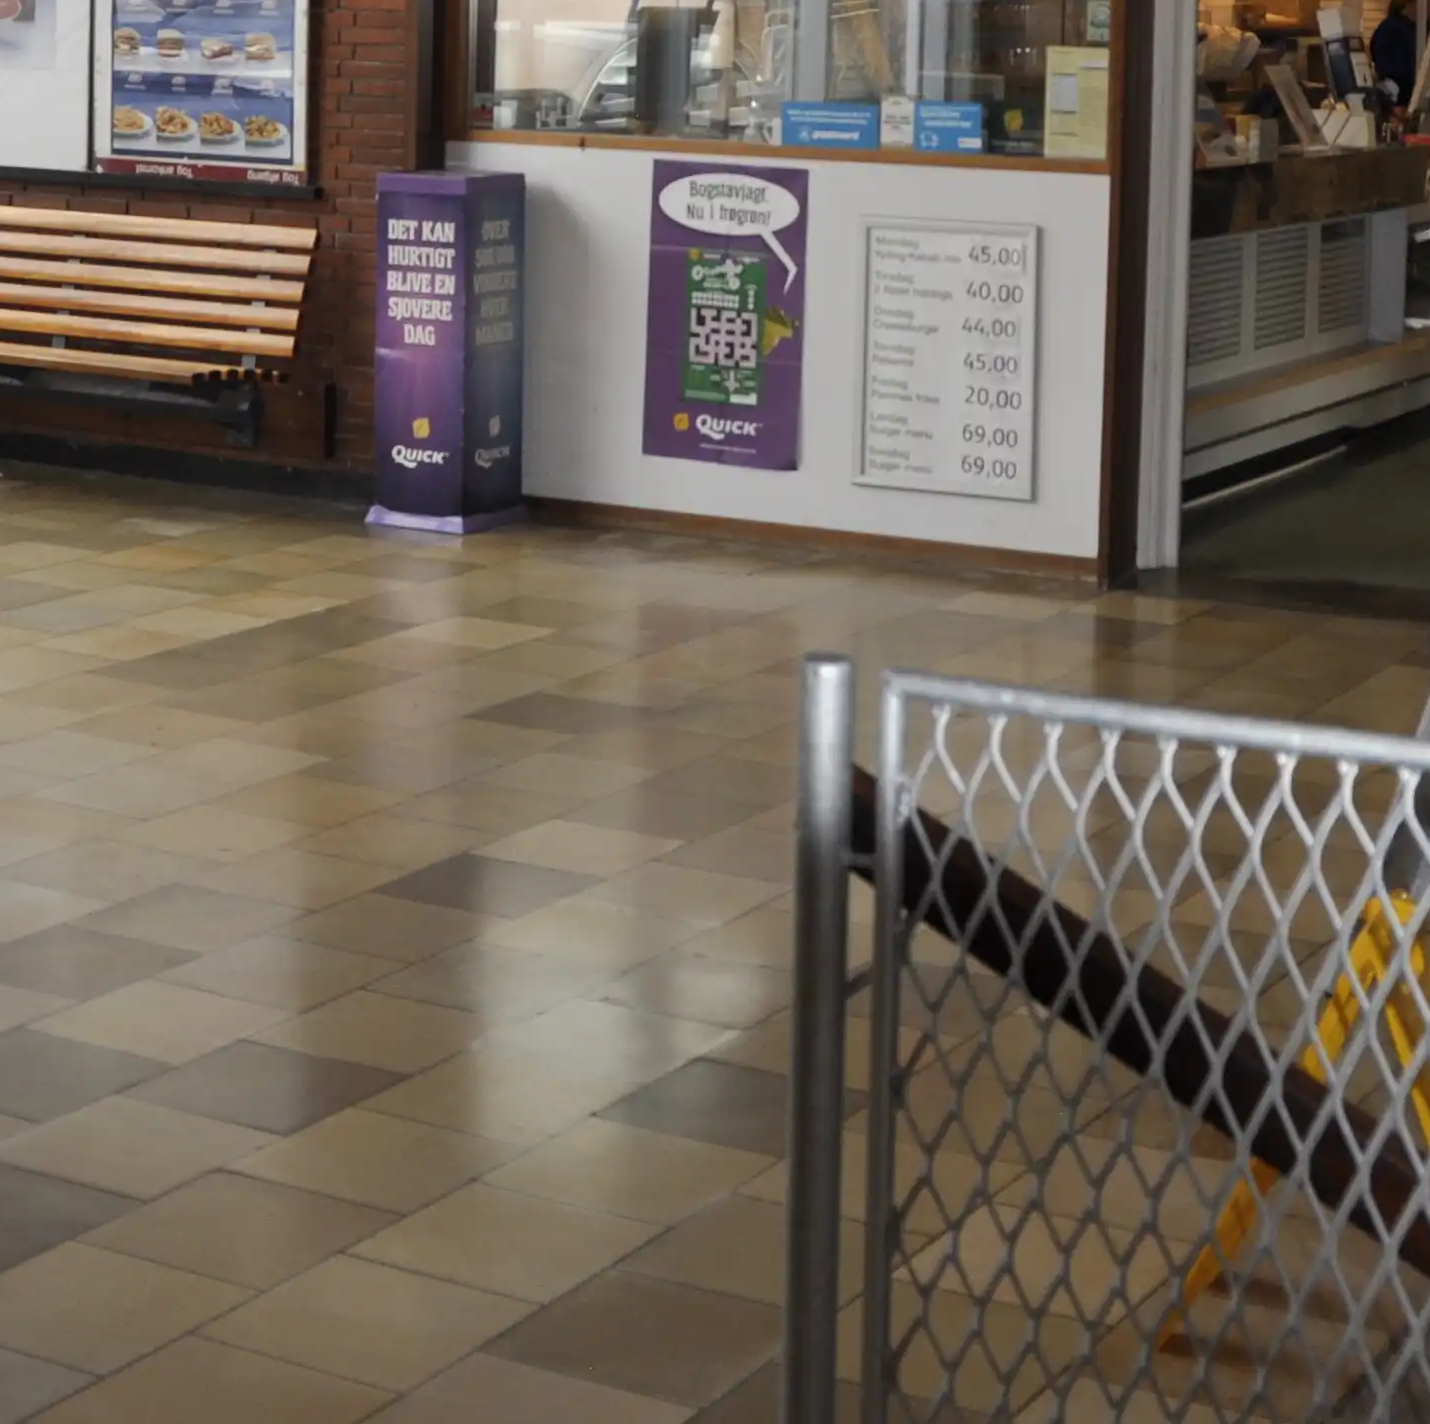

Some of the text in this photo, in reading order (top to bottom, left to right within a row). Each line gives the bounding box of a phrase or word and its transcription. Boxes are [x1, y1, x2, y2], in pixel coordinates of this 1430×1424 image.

[387, 219, 456, 243] DET KAN
[387, 244, 456, 269] HURTIGT
[386, 270, 456, 295] BLIVE EN
[387, 296, 453, 322] SJOVERE
[403, 323, 437, 347] DAG
[961, 315, 1017, 339] 44,00
[964, 384, 1023, 411] 20,00
[695, 412, 759, 439] QUICK
[962, 423, 1019, 449] 69,00
[391, 444, 447, 469] QUICK
[961, 454, 1017, 480] 69,00
